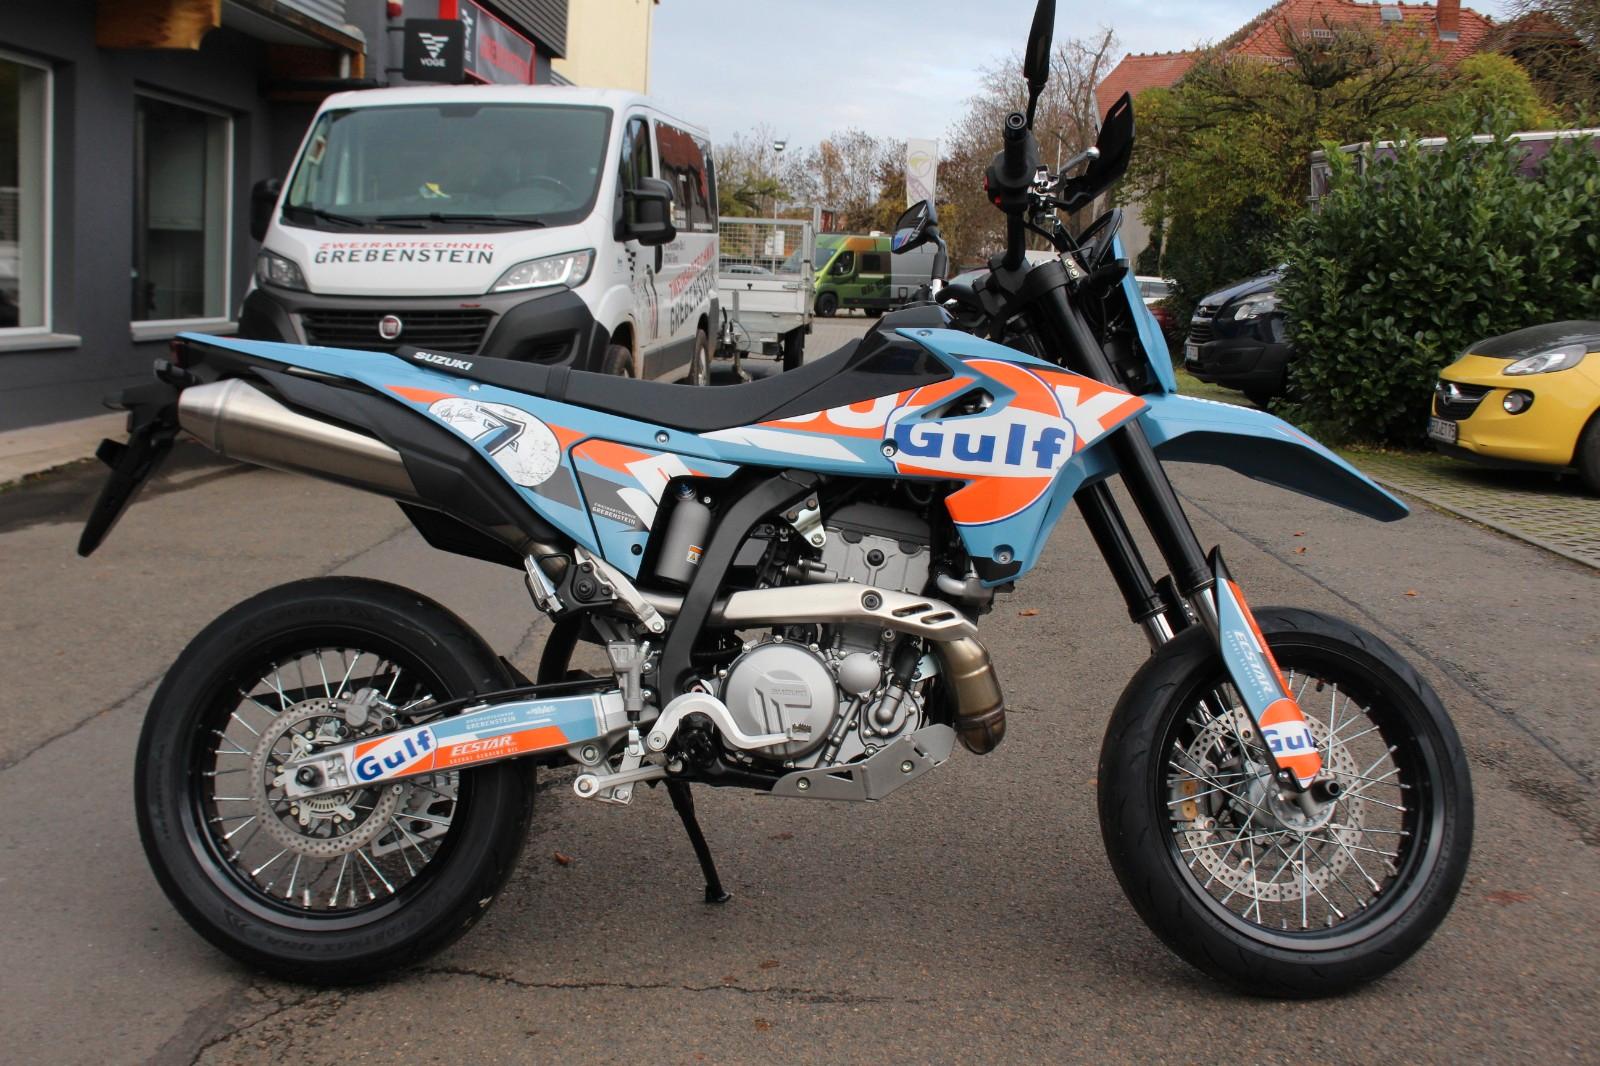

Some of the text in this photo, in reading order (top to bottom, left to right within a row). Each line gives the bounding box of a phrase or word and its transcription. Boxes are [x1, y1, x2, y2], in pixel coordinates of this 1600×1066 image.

[420, 58, 446, 67] VOGE
[319, 242, 495, 250] ZWEIRADTECHNIK
[314, 249, 494, 265] GREBENSTEIN
[413, 351, 474, 371] SUZUKI
[893, 421, 1066, 469] Gulf
[592, 506, 636, 526] GREBENSTEIN
[1234, 631, 1274, 693] ECSTAR
[451, 735, 513, 756] ECSTAR
[1263, 727, 1313, 753] Gul
[356, 729, 431, 781] Gulf
